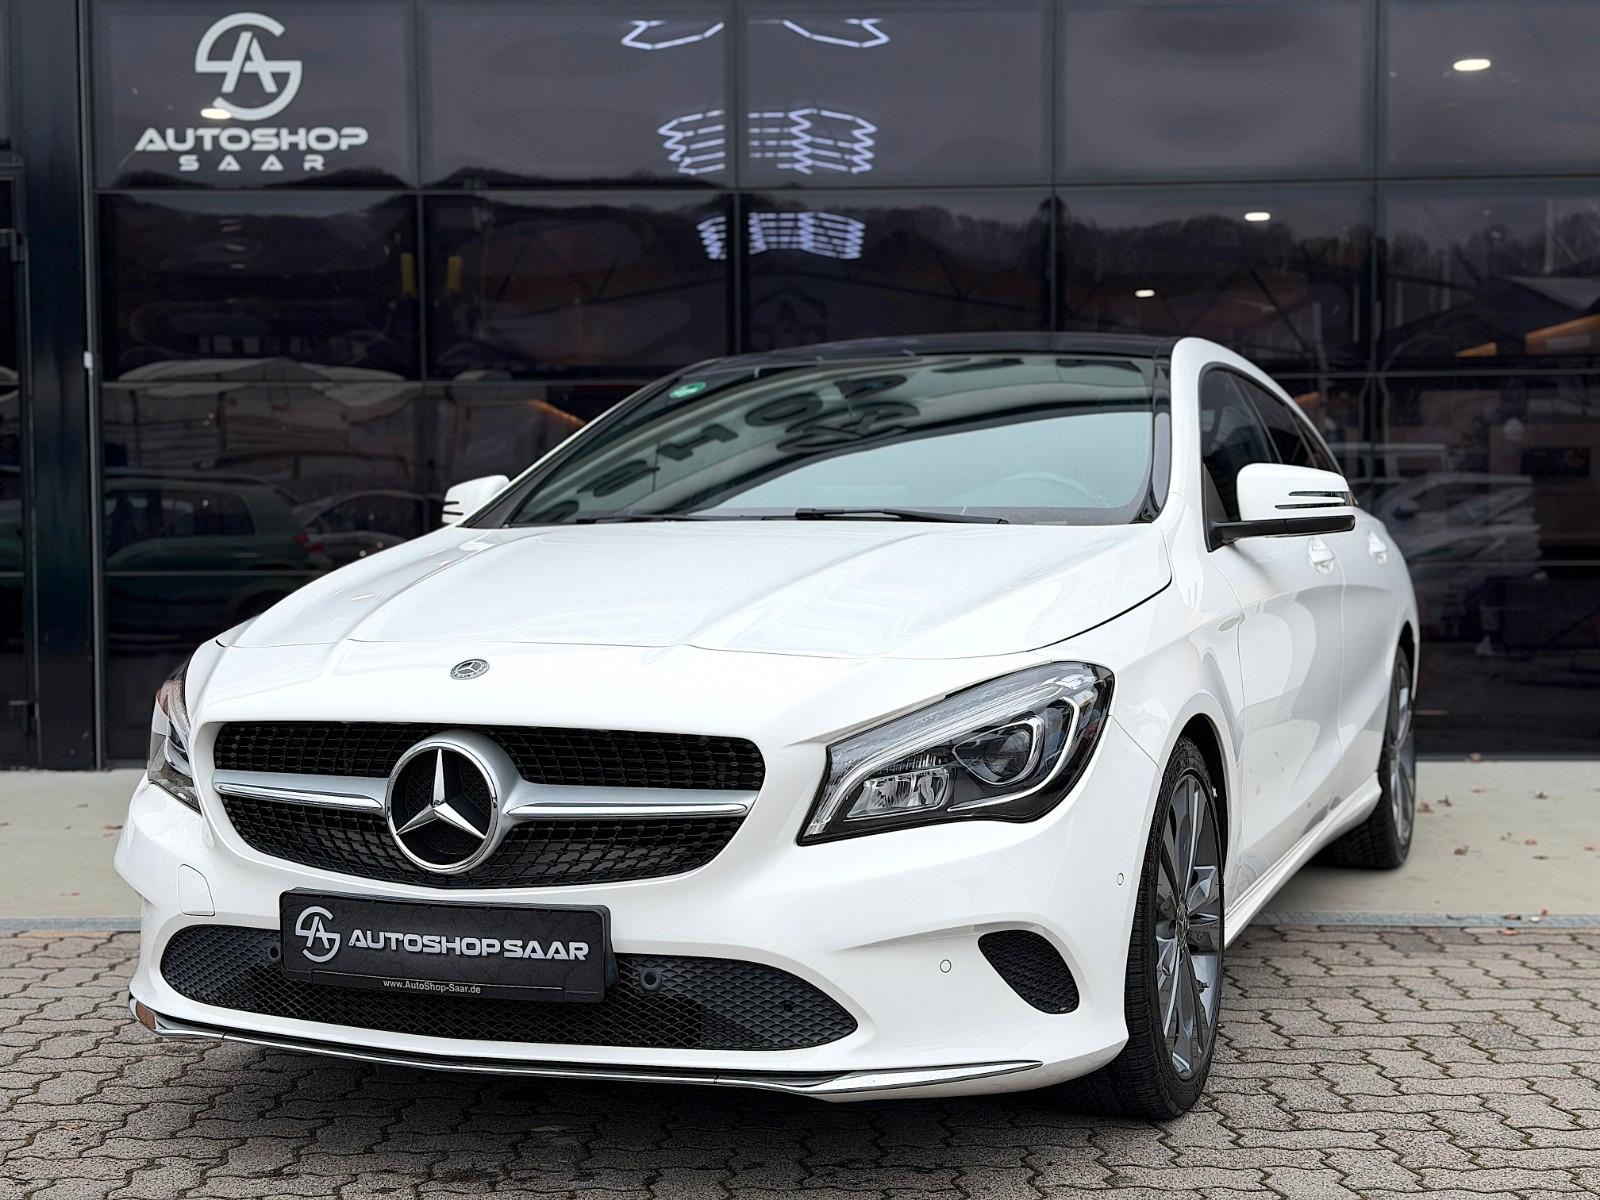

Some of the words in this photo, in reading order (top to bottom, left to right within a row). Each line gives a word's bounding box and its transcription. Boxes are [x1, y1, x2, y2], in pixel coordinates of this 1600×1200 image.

[134, 127, 369, 151] AUTOSHOP
[178, 154, 325, 171] SAAR
[348, 929, 501, 957] AUTOSHOP
[503, 940, 589, 961] SAAR
[382, 980, 481, 994] www.AutoShop-Saar.de
